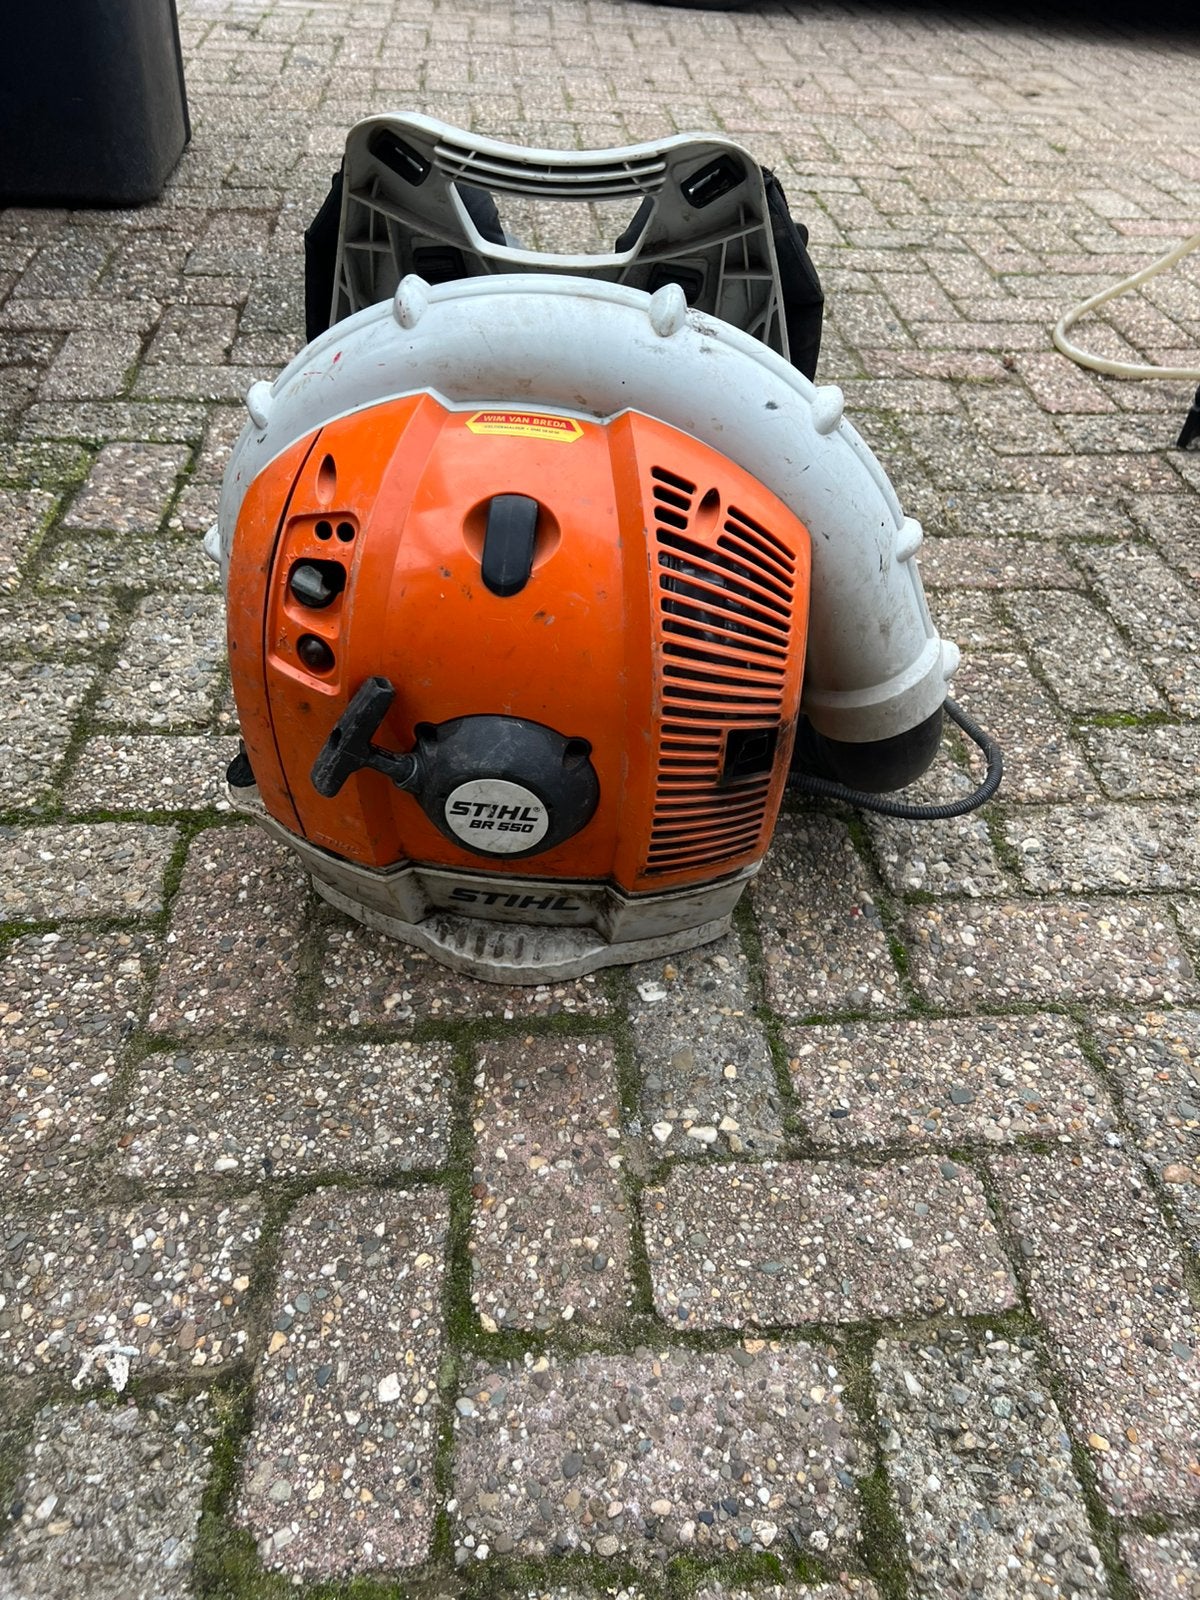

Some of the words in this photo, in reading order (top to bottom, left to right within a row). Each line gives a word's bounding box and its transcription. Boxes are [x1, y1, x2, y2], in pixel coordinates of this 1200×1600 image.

[508, 416, 530, 424] VAN
[532, 418, 567, 429] BREDA
[449, 801, 539, 822] STIHL
[469, 819, 495, 830] BR
[497, 822, 535, 833] 550
[448, 887, 581, 911] STIHL
